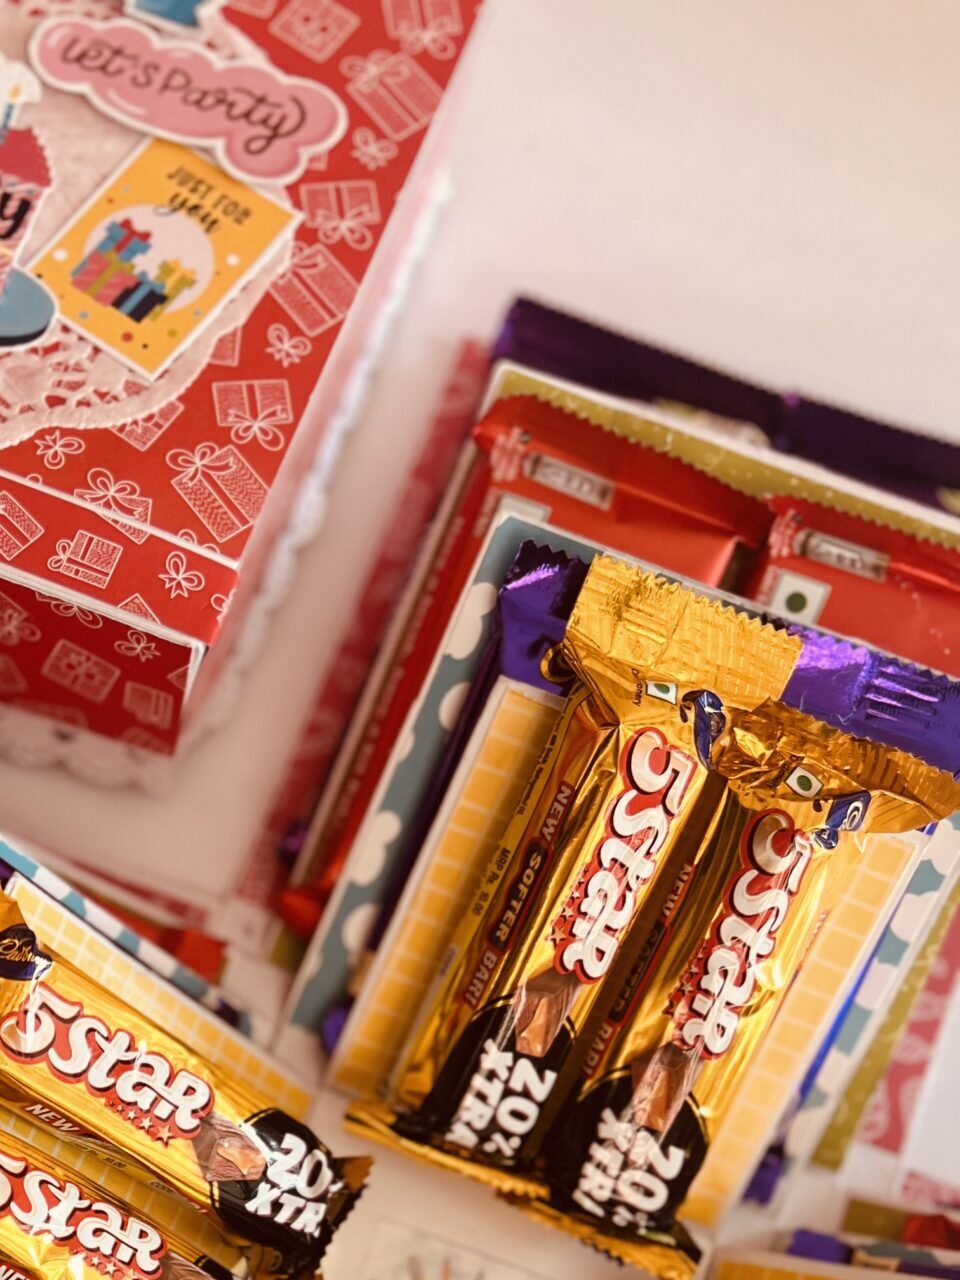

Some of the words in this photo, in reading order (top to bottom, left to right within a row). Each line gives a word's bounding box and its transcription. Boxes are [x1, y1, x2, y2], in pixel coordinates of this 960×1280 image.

[541, 785, 573, 842] NEW
[495, 853, 544, 942] SOFTER
[464, 950, 501, 1009] BAR!
[24, 1105, 81, 1133] NEW
